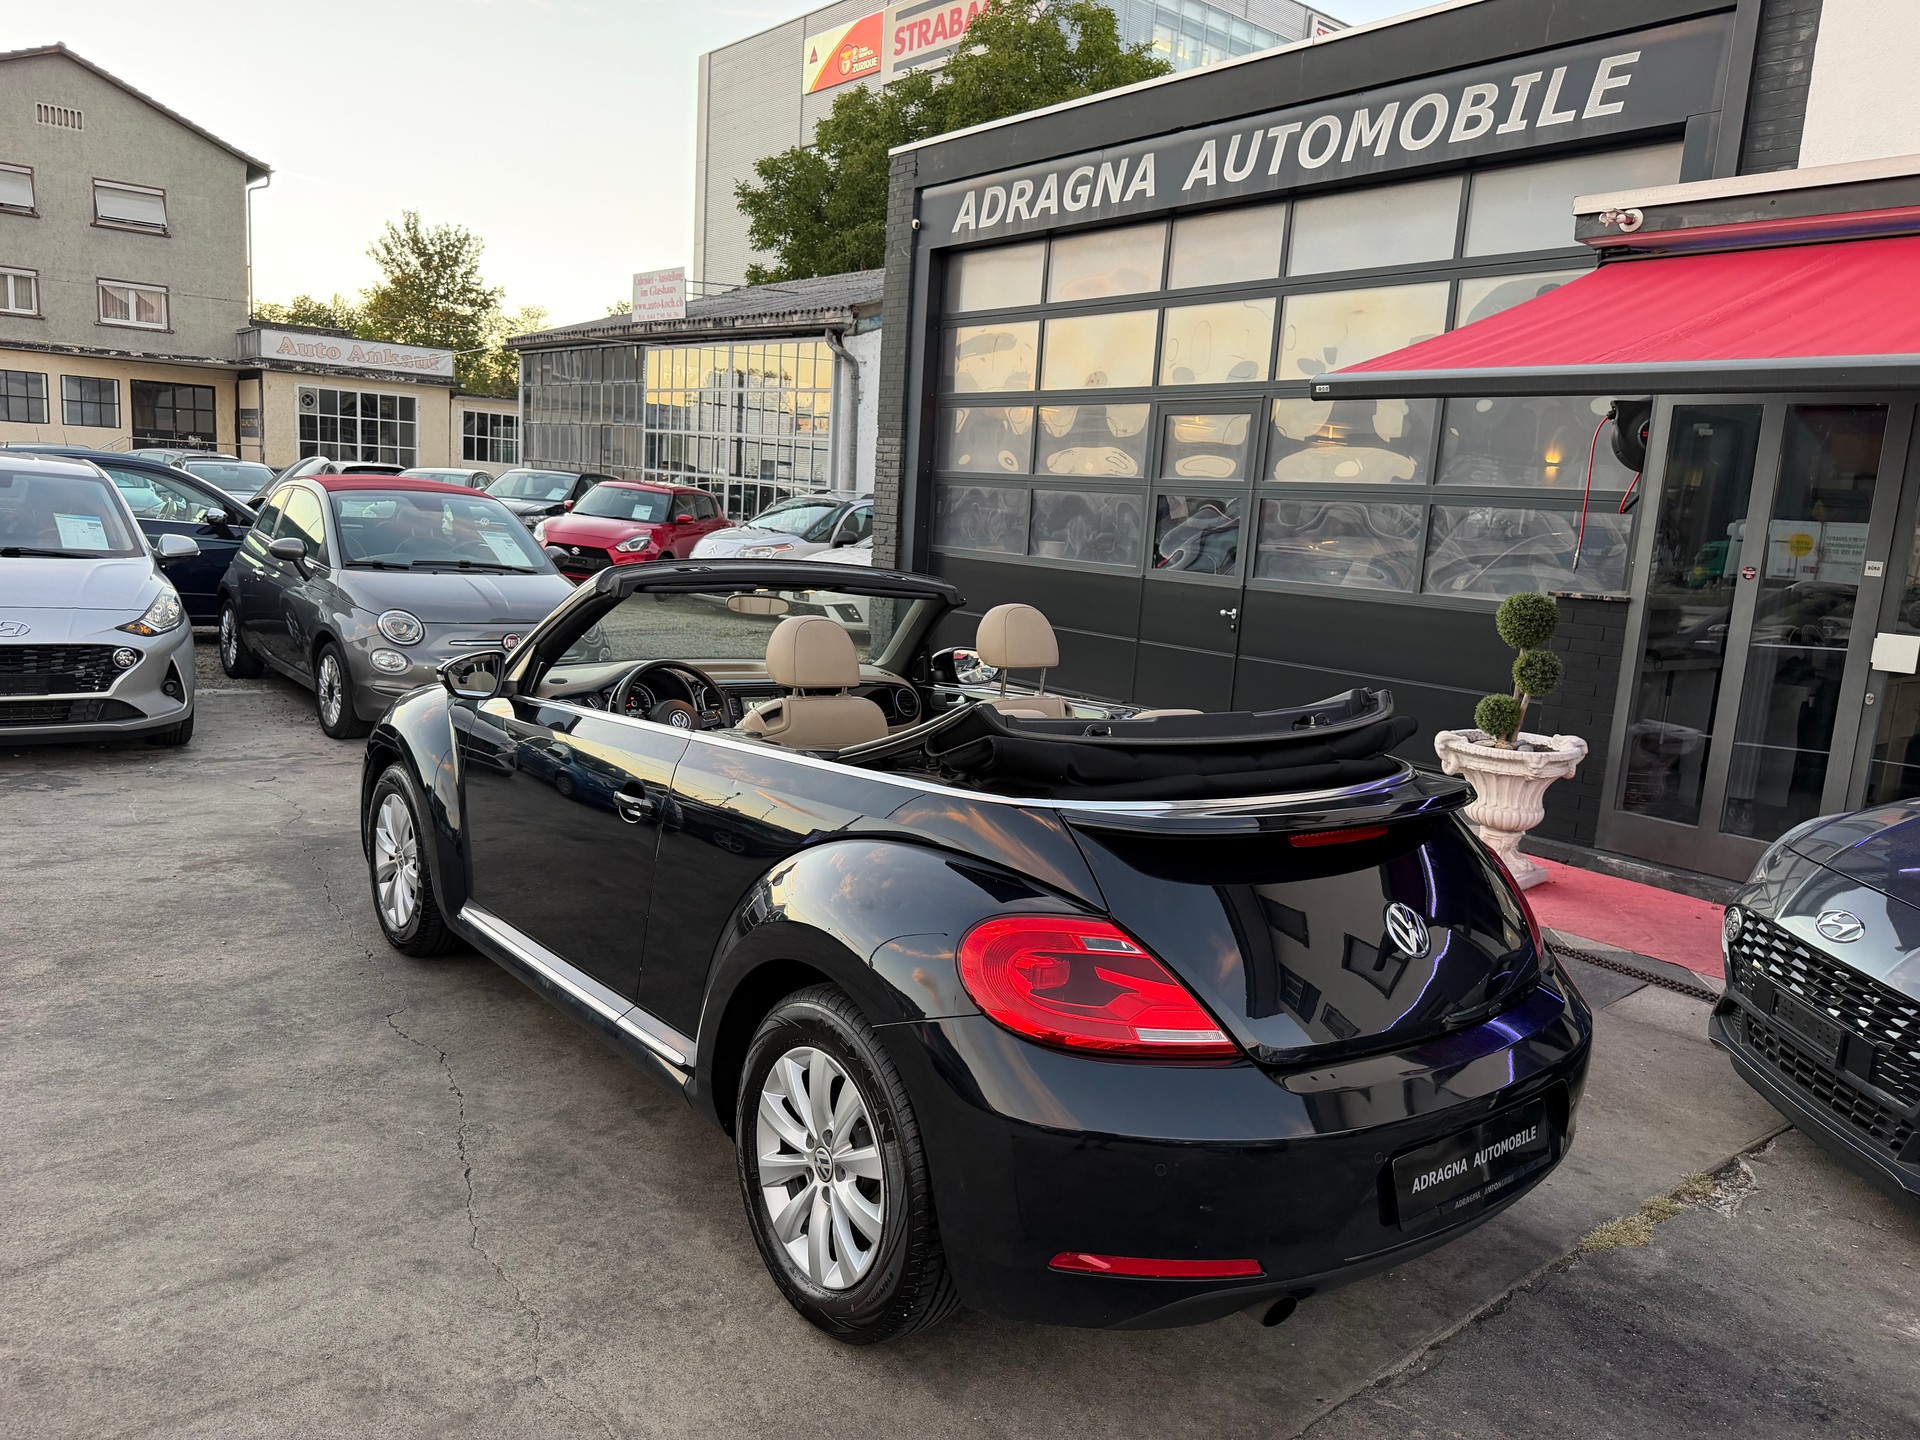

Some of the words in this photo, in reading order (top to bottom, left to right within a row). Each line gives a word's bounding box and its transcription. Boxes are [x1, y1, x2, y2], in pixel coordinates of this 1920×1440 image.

[893, 0, 1003, 57] STRABA
[852, 57, 878, 74] ZURIQUE
[952, 153, 1156, 233] ADRAGNA
[1182, 51, 1641, 190] AUTOMOBILE
[640, 287, 649, 297] im
[650, 285, 677, 297] Glashaus
[276, 336, 341, 360] Auto
[347, 345, 441, 370] Ankauf
[1412, 1158, 1468, 1195] ADRAGNA
[1473, 1125, 1537, 1168] AUTOMOBILE
